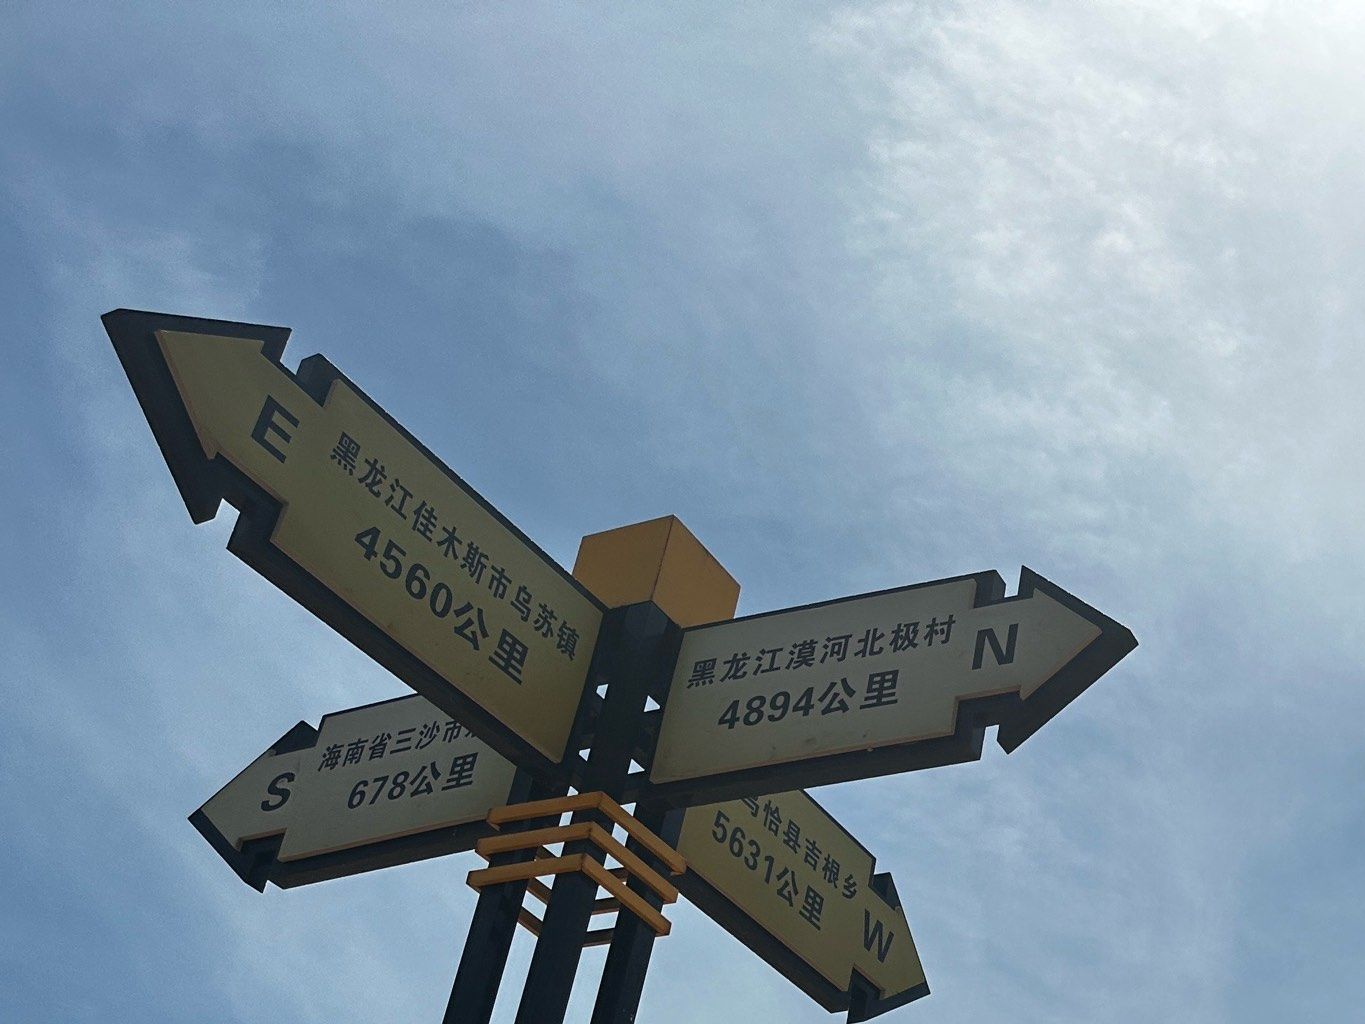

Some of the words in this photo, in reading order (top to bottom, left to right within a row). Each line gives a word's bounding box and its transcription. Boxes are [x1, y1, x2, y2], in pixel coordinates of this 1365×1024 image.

[251, 395, 300, 463] E
[330, 431, 580, 661] 黑龙江佳木斯市乌苏镇
[354, 526, 529, 685] 4560公里
[686, 615, 955, 689] 黑龙江漠河北极村
[971, 624, 1019, 670] N
[718, 670, 899, 730] 4894公里
[318, 720, 476, 772] 海南省三沙市
[261, 772, 295, 812] S
[347, 752, 478, 809] 678公里
[712, 810, 824, 931] 5631公里
[863, 908, 894, 963] W
